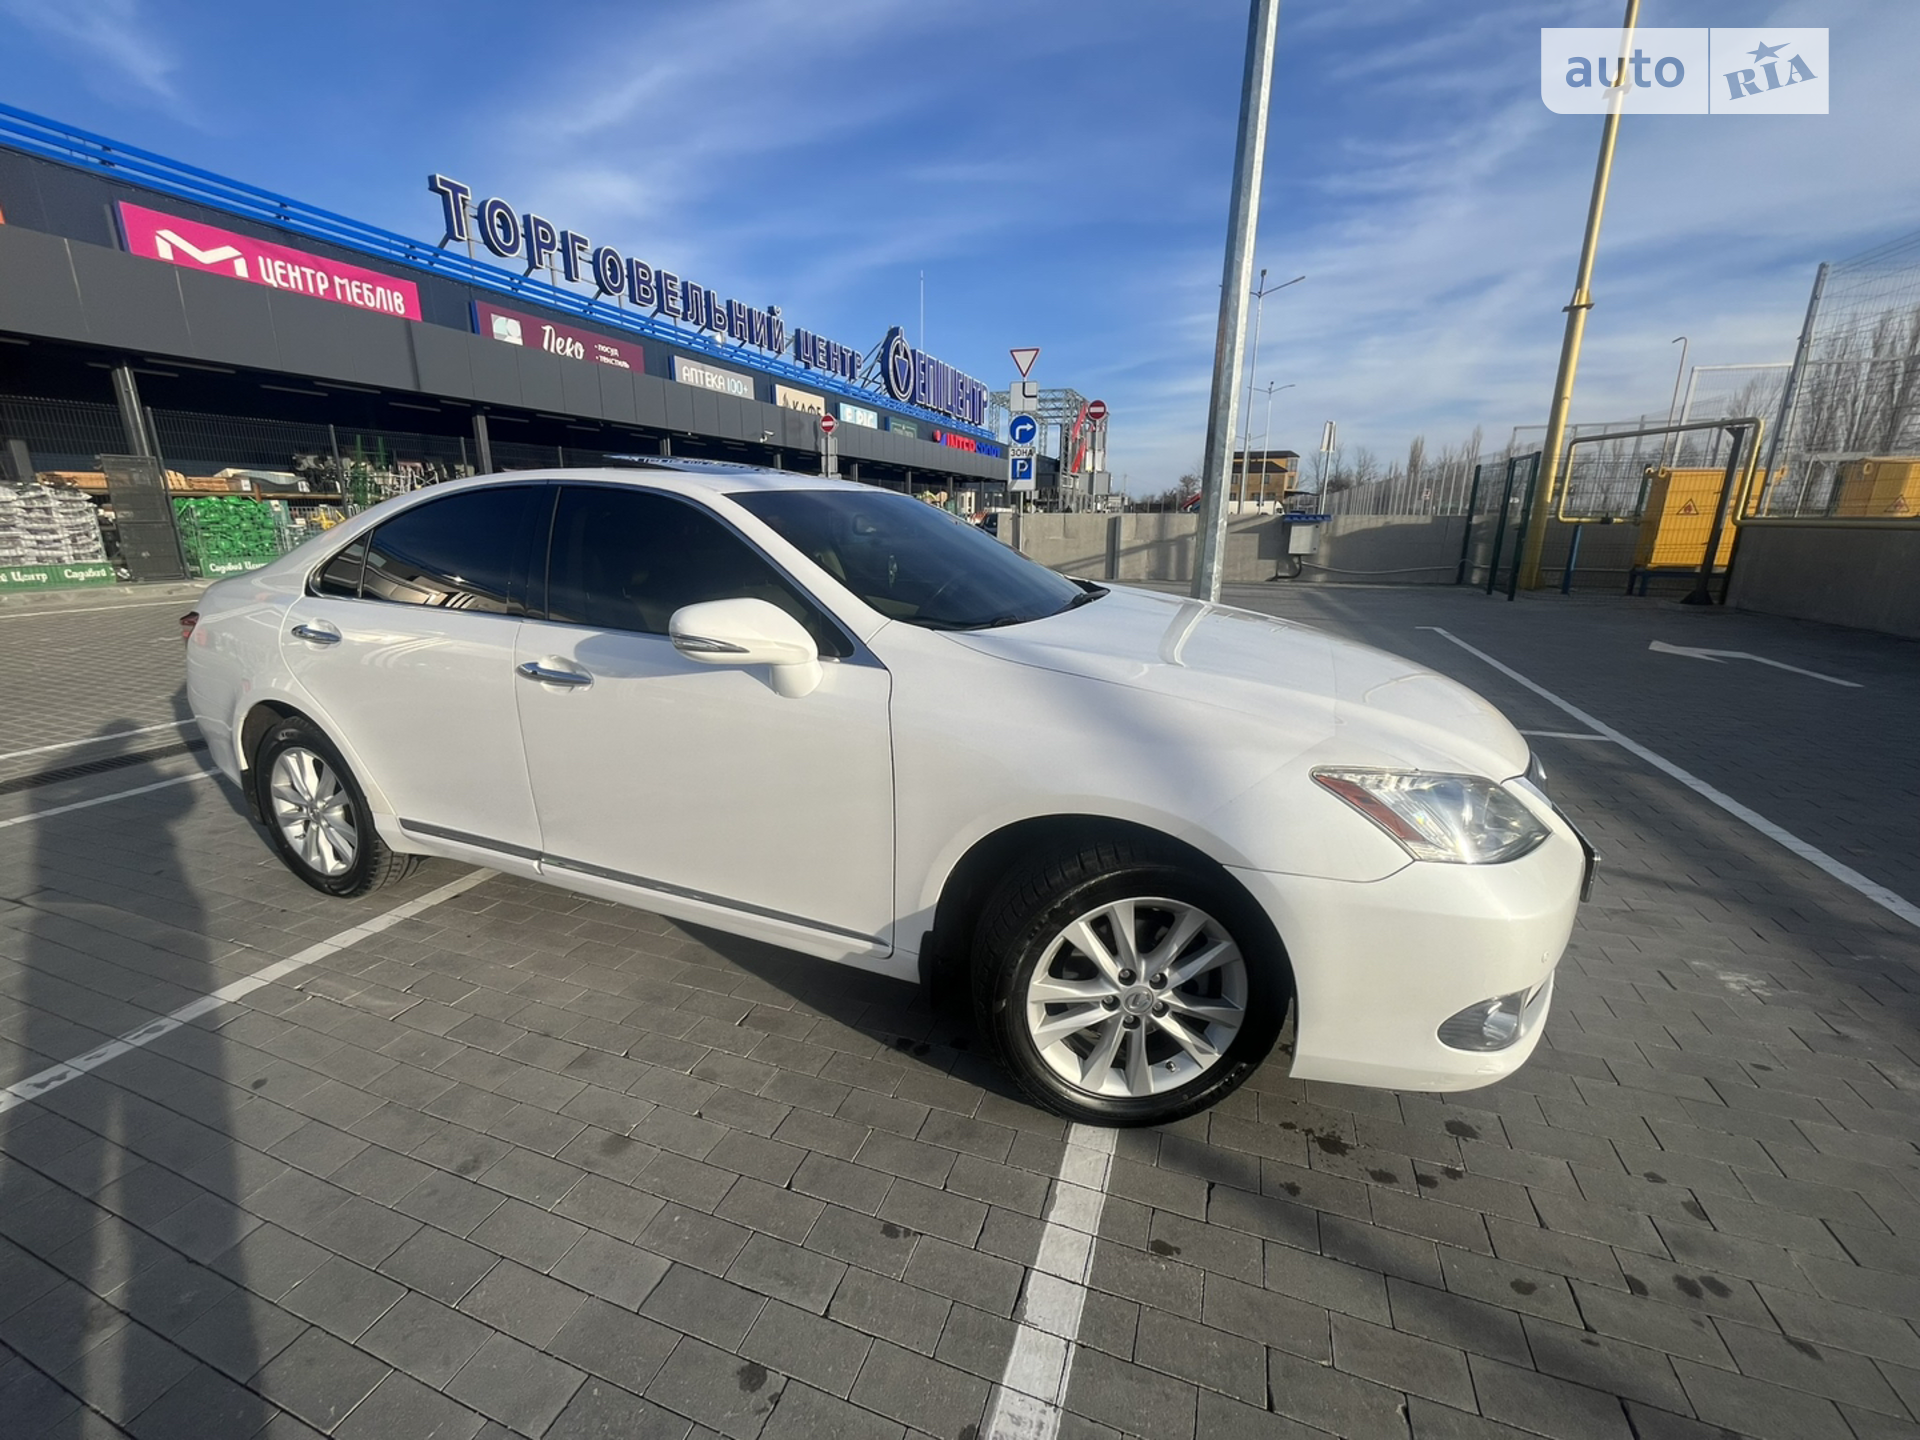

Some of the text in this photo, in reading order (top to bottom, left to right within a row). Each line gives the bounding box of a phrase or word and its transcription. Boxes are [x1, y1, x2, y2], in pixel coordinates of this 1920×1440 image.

[258, 255, 405, 315] ЦЕНТР МЕБЛІВ
[428, 173, 989, 426] ТОРГОВЕЛЬНИЙ ЦЕНТР ЕПІЦЕНТР
[682, 365, 749, 396] АПТЕКА 100+
[1010, 448, 1034, 457] ЗОНА
